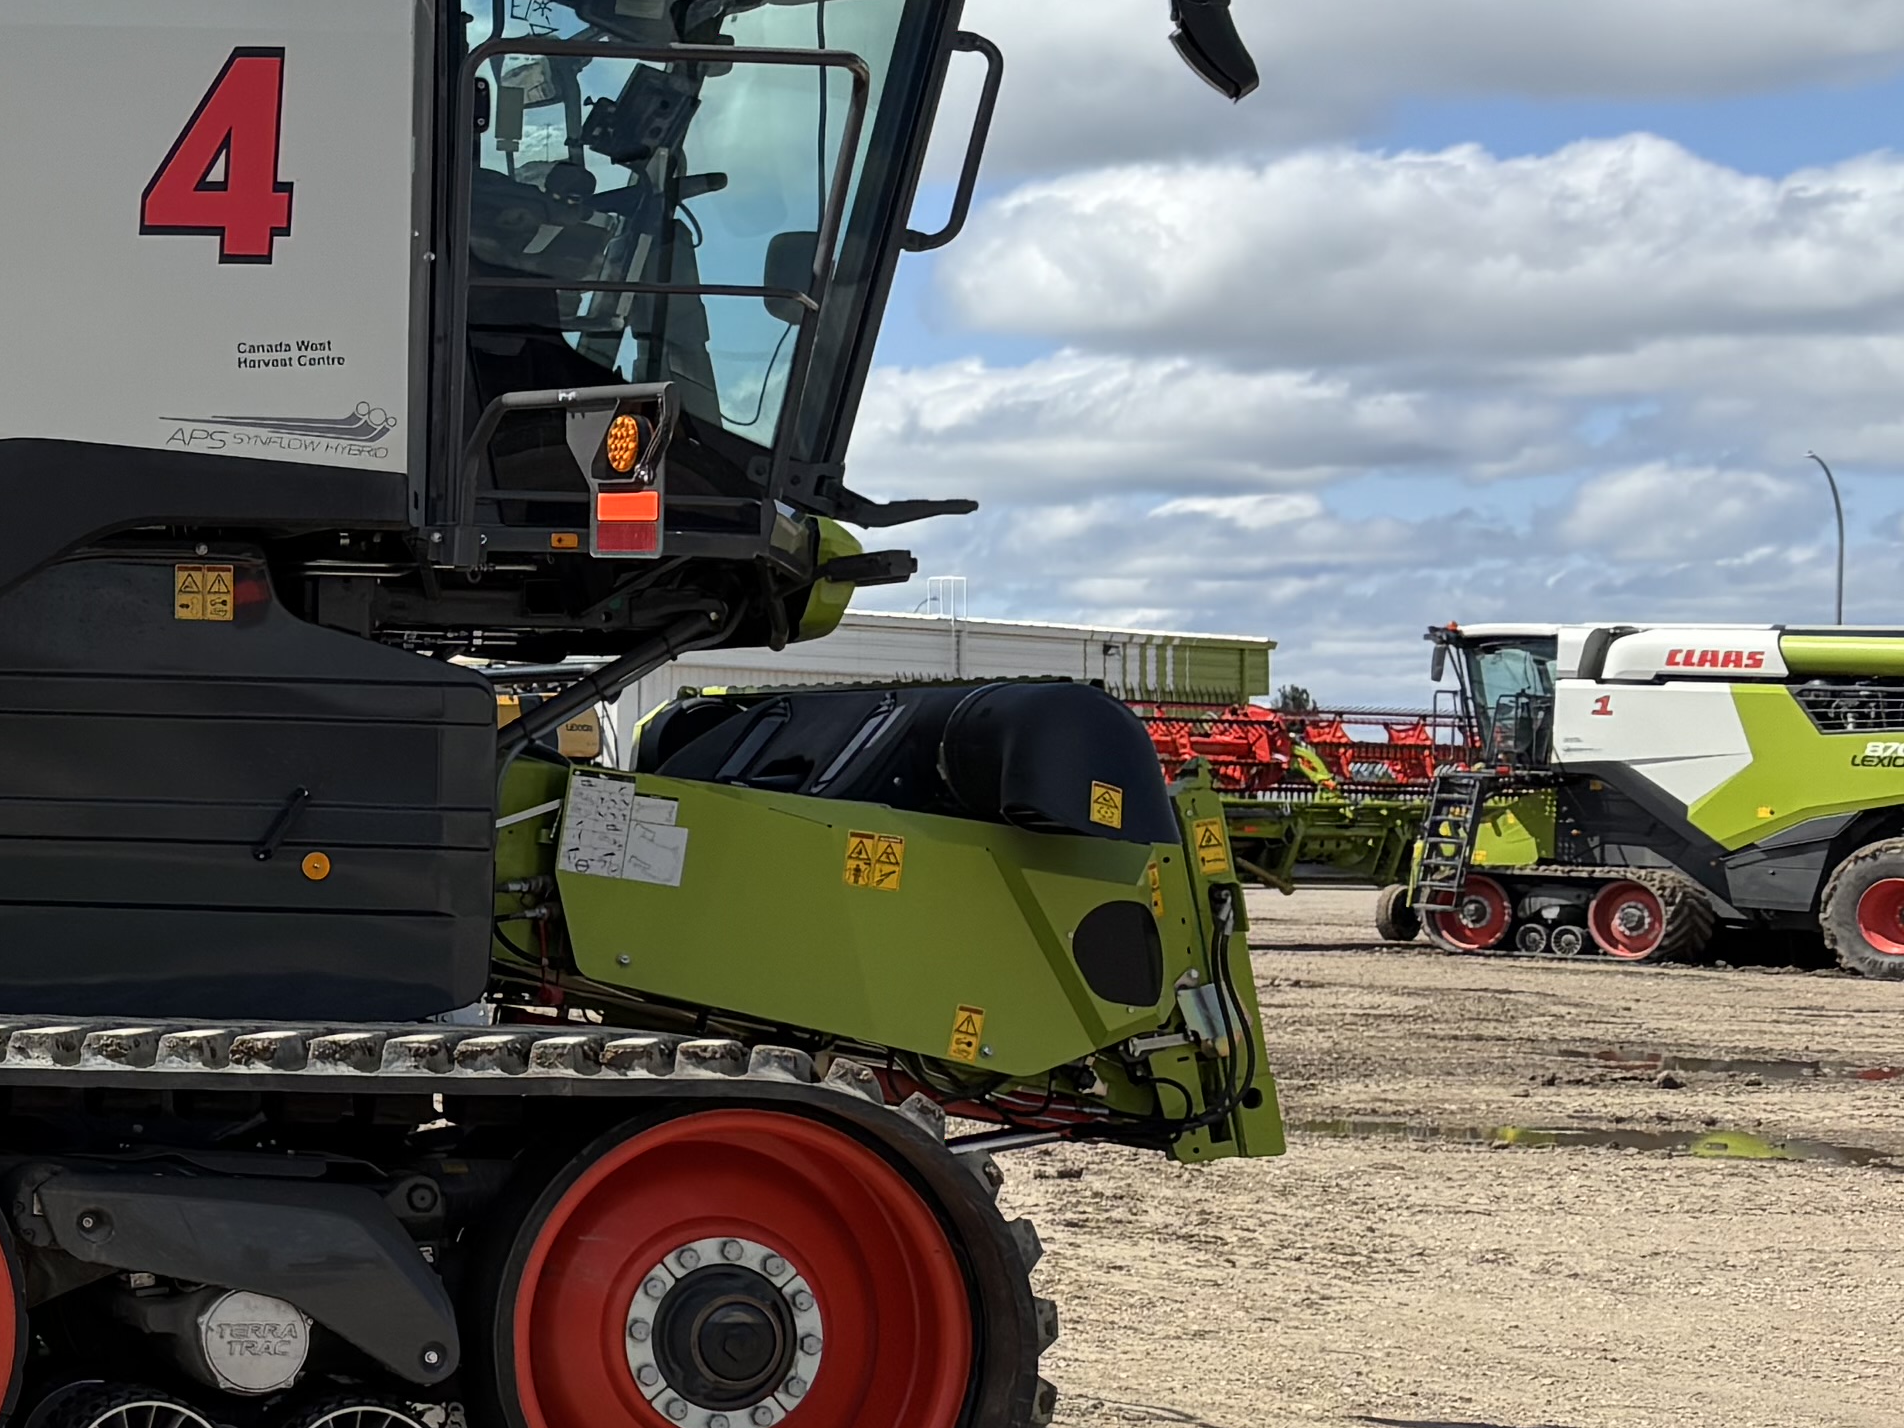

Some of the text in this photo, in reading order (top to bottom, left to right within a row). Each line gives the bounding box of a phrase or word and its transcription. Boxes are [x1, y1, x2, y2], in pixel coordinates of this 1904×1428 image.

[139, 47, 294, 265] 4
[237, 341, 292, 354] Canada
[165, 427, 390, 460] APS SYNFLOW HYBRID
[1664, 648, 1766, 670] CLAAS
[1592, 694, 1614, 717] 1
[217, 1323, 298, 1339] TERRA
[227, 1340, 291, 1357] TRAC
